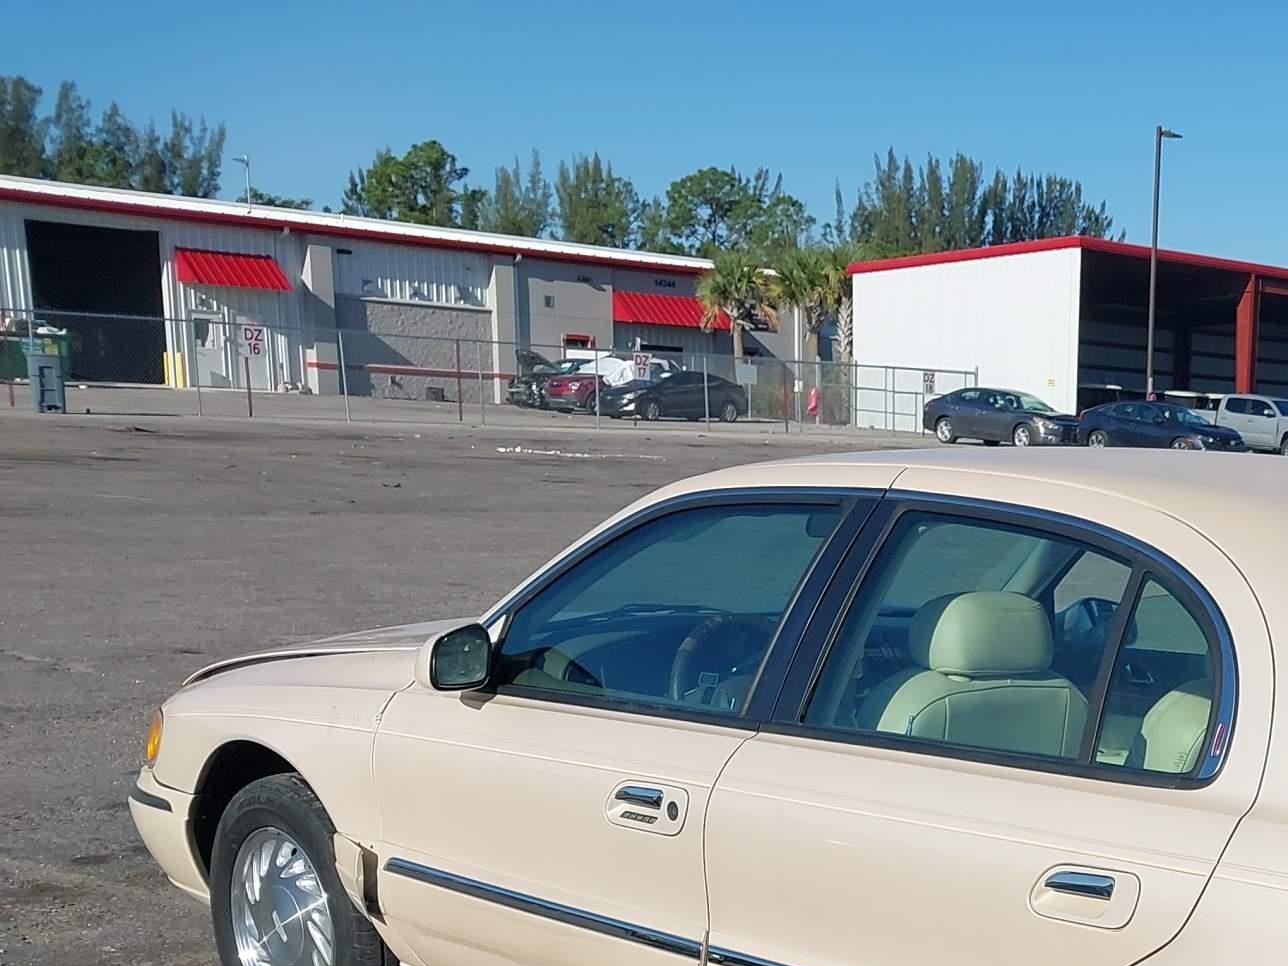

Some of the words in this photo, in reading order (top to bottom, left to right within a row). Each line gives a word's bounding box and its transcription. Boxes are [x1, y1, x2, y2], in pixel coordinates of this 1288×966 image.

[244, 328, 263, 341] DZ
[248, 342, 260, 355] 16
[635, 354, 649, 366] DZ
[638, 367, 646, 378] 17
[923, 372, 935, 384] DZ
